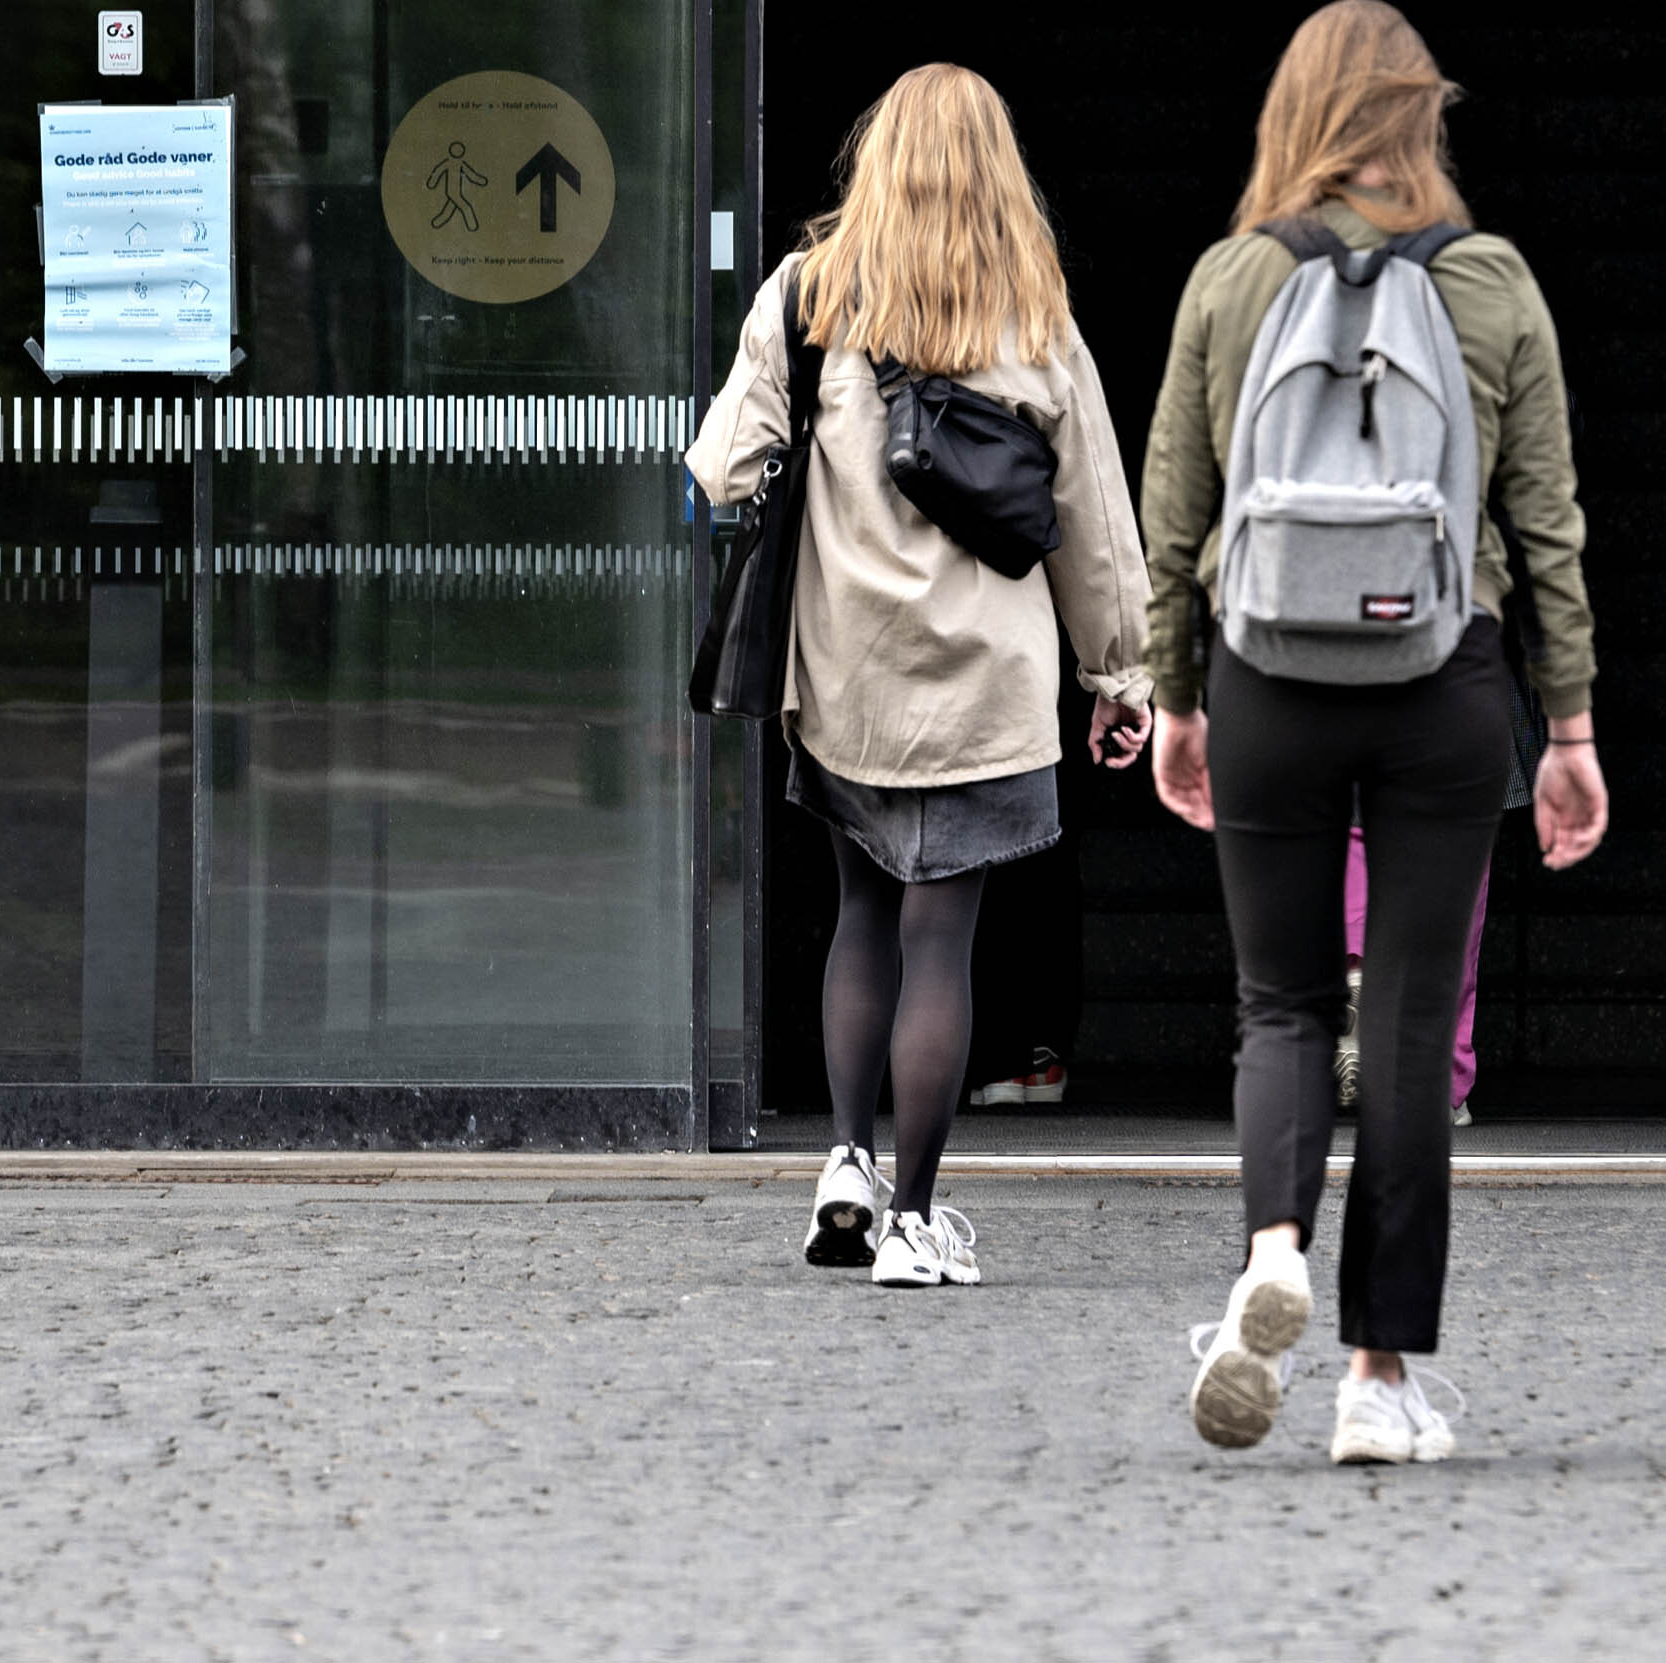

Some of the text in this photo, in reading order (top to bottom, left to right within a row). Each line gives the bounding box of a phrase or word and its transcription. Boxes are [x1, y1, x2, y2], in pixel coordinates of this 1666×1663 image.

[109, 53, 132, 61] VAGT
[438, 101, 459, 110] Hold
[54, 152, 213, 167] Gode råd Gode vaner
[431, 255, 453, 266] Keep
[454, 255, 476, 266] right
[484, 255, 506, 266] Keep
[507, 256, 527, 267] your
[528, 255, 564, 266] distance
